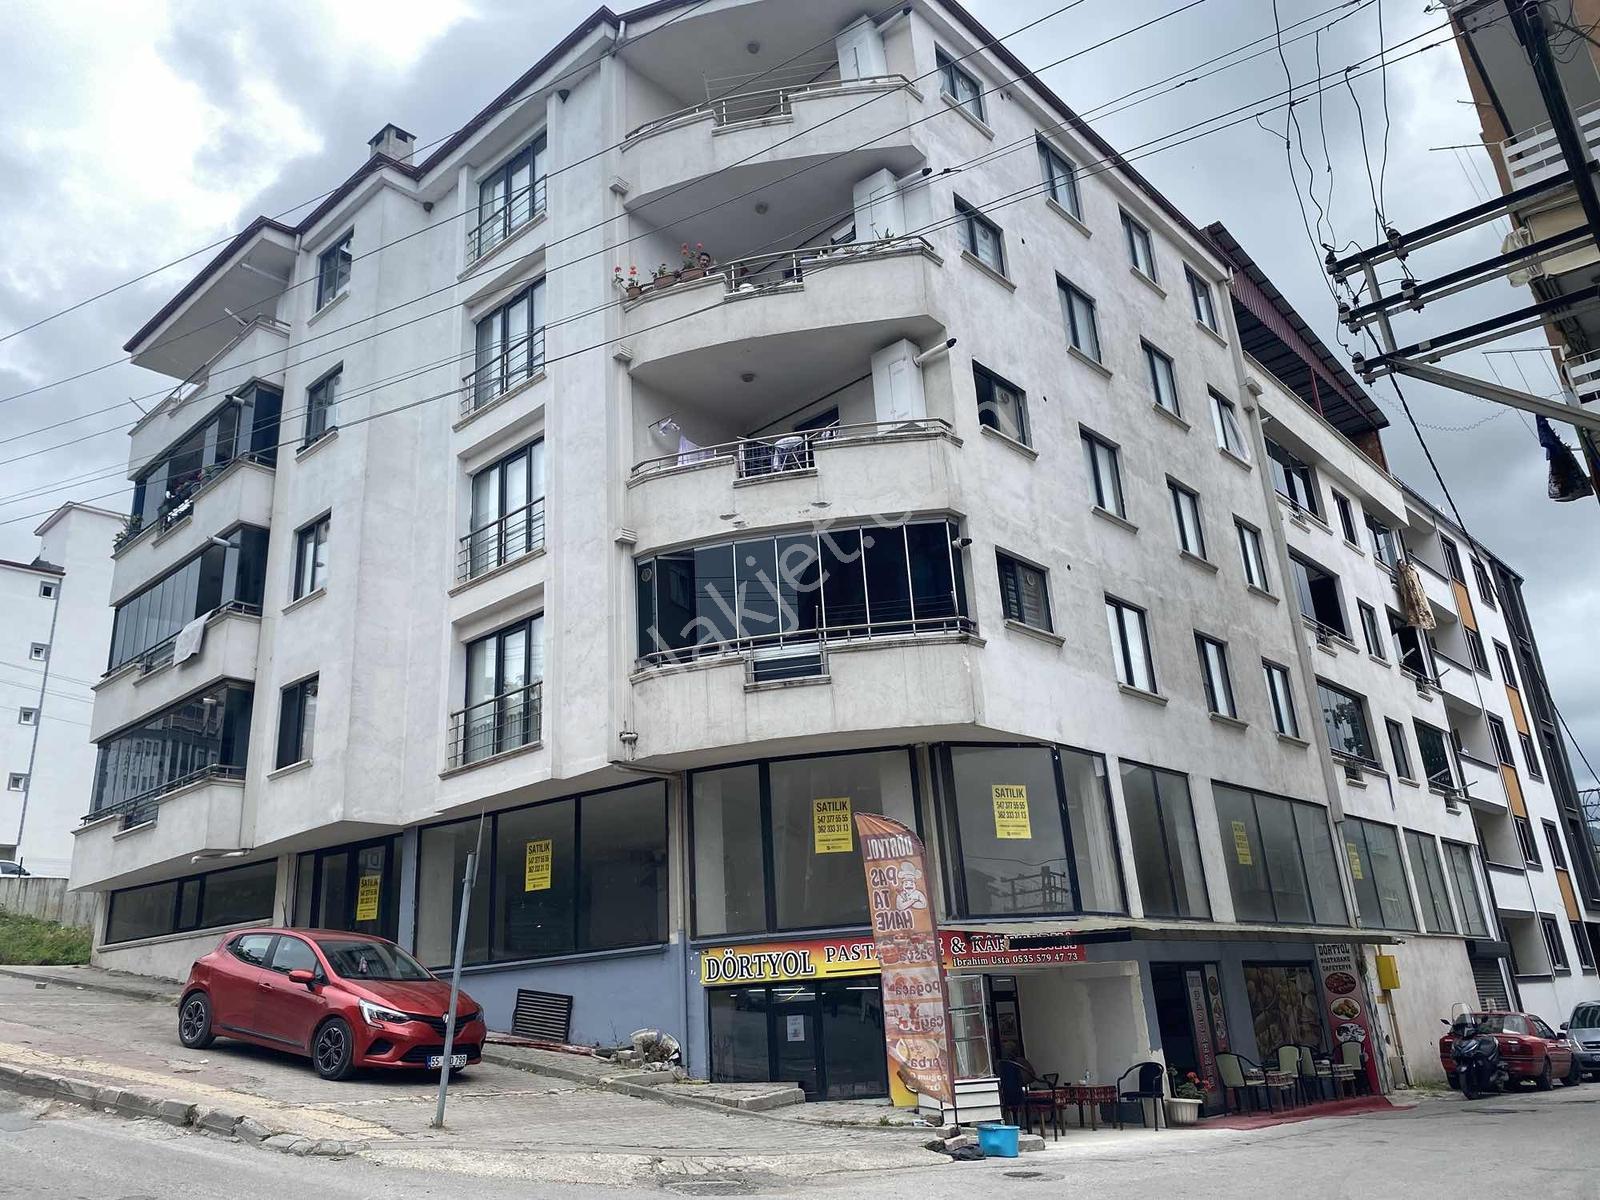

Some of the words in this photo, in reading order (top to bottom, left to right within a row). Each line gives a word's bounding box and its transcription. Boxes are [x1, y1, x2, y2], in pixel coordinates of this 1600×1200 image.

[995, 787, 1024, 798] SATILIK
[816, 801, 848, 812] SATILIK
[817, 815, 826, 824] 547
[827, 815, 835, 823] 377
[836, 814, 841, 822] 55
[842, 814, 848, 822] 55
[528, 842, 550, 855] SATILIK
[705, 949, 814, 982] DÖRTYOL
[950, 936, 966, 954] &
[991, 956, 1010, 965] Usta
[1012, 954, 1033, 964] 0535
[1036, 953, 1051, 963] 579
[1054, 953, 1065, 962] 47
[1067, 953, 1078, 961] 73
